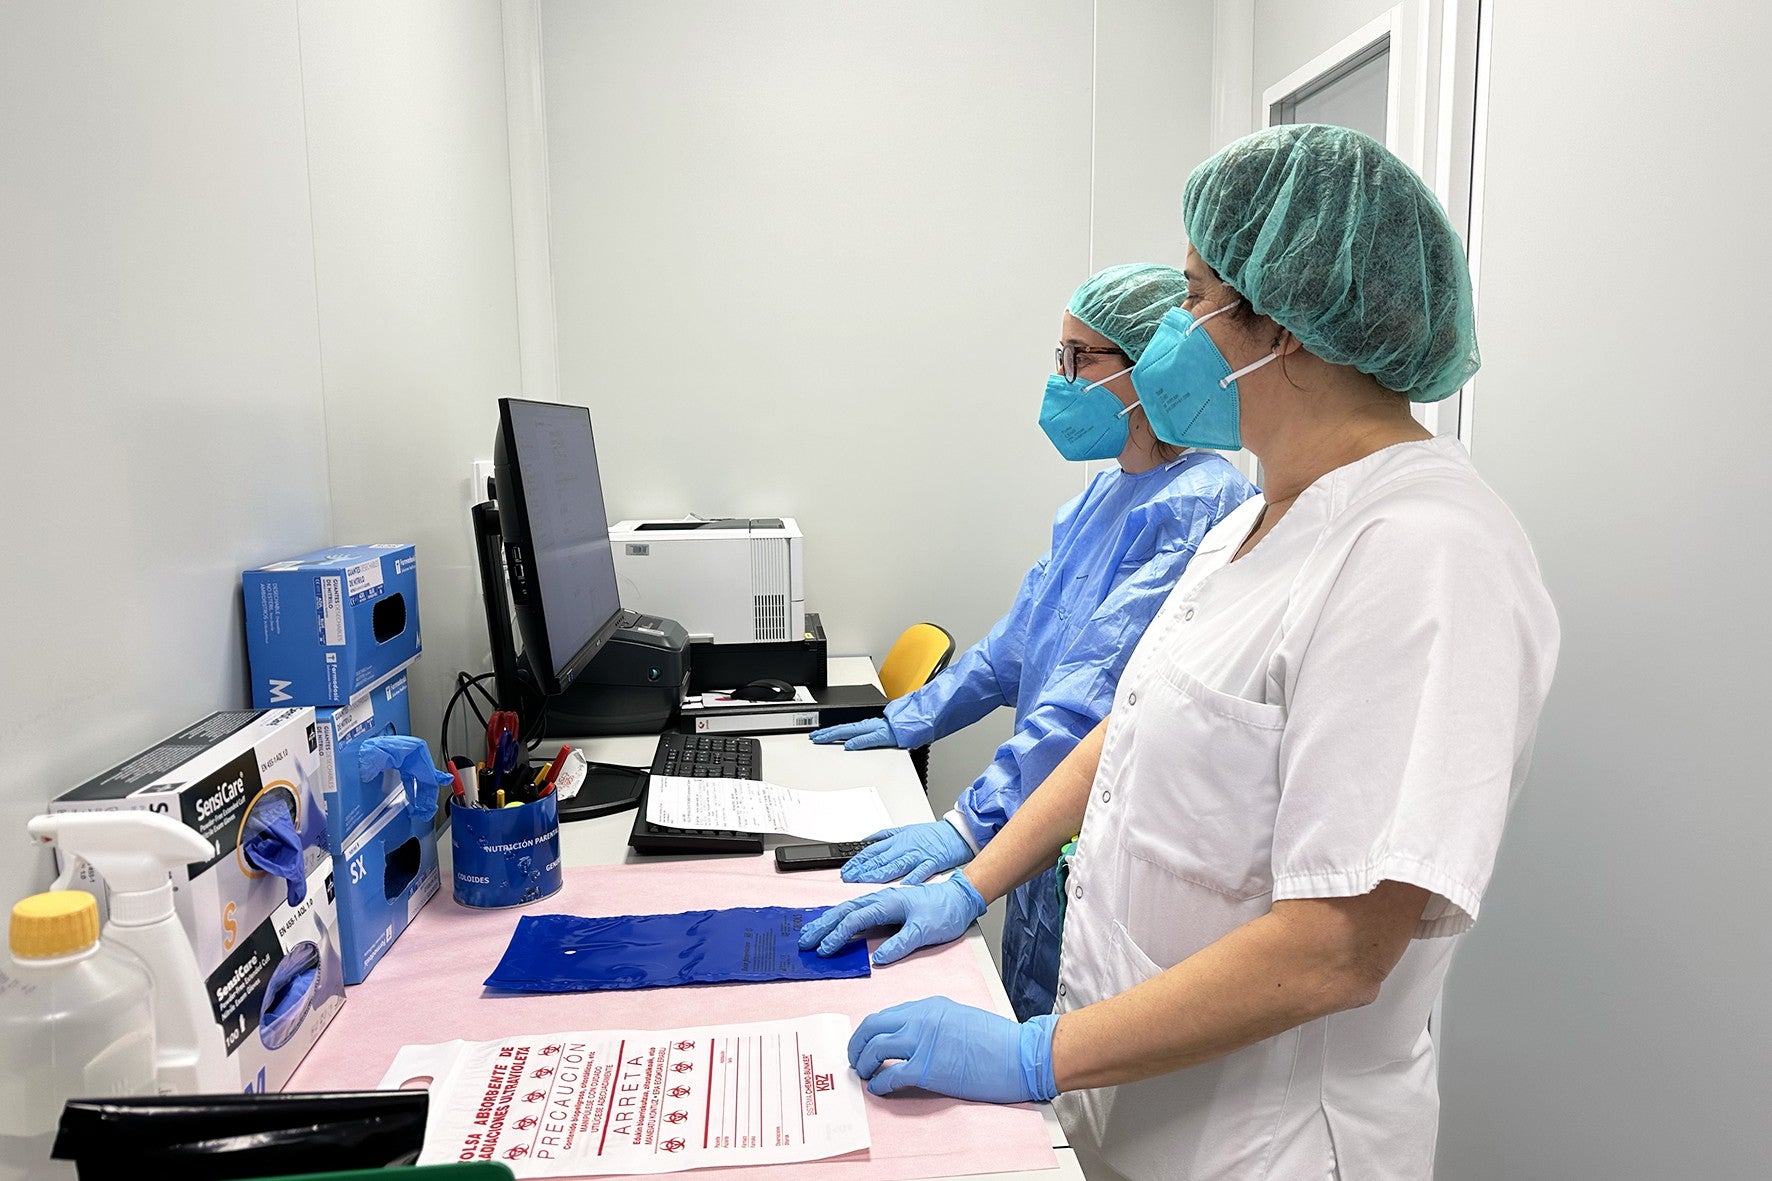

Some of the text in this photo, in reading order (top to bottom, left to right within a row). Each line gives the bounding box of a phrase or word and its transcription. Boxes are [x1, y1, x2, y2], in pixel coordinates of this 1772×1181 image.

[326, 579, 331, 587] DE
[335, 603, 344, 642] DESECHABLES
[269, 679, 293, 703] M
[317, 726, 322, 735] DE
[195, 771, 244, 821] SensiCare
[484, 839, 534, 853] NUTRICIÓN
[457, 872, 490, 884] COLOIDES
[223, 901, 237, 951] S
[278, 926, 286, 937] EN
[286, 914, 298, 929] 455-1
[297, 905, 307, 918] AQL
[261, 953, 271, 966] Cuff
[216, 951, 257, 1002] SensiCare
[235, 992, 248, 1007] Exam
[246, 978, 261, 994] Gloves
[226, 1028, 239, 1047] 100
[590, 1065, 603, 1088] CUIDADO
[597, 1063, 614, 1107] ADECUADAMENTE
[815, 1073, 830, 1092] KRZ
[457, 1046, 515, 1163] OLSA ABSORBENTE DE
[478, 1046, 531, 1161] ADIACIONES ULTRAVIOLETA
[537, 1043, 586, 1160] PRECAUCIÓN
[587, 1088, 597, 1099] CON
[613, 1055, 644, 1135] ARRETA
[806, 1095, 814, 1116] SISTEMA
[563, 1122, 578, 1150] Contenido
[632, 1127, 643, 1145] Edukin
